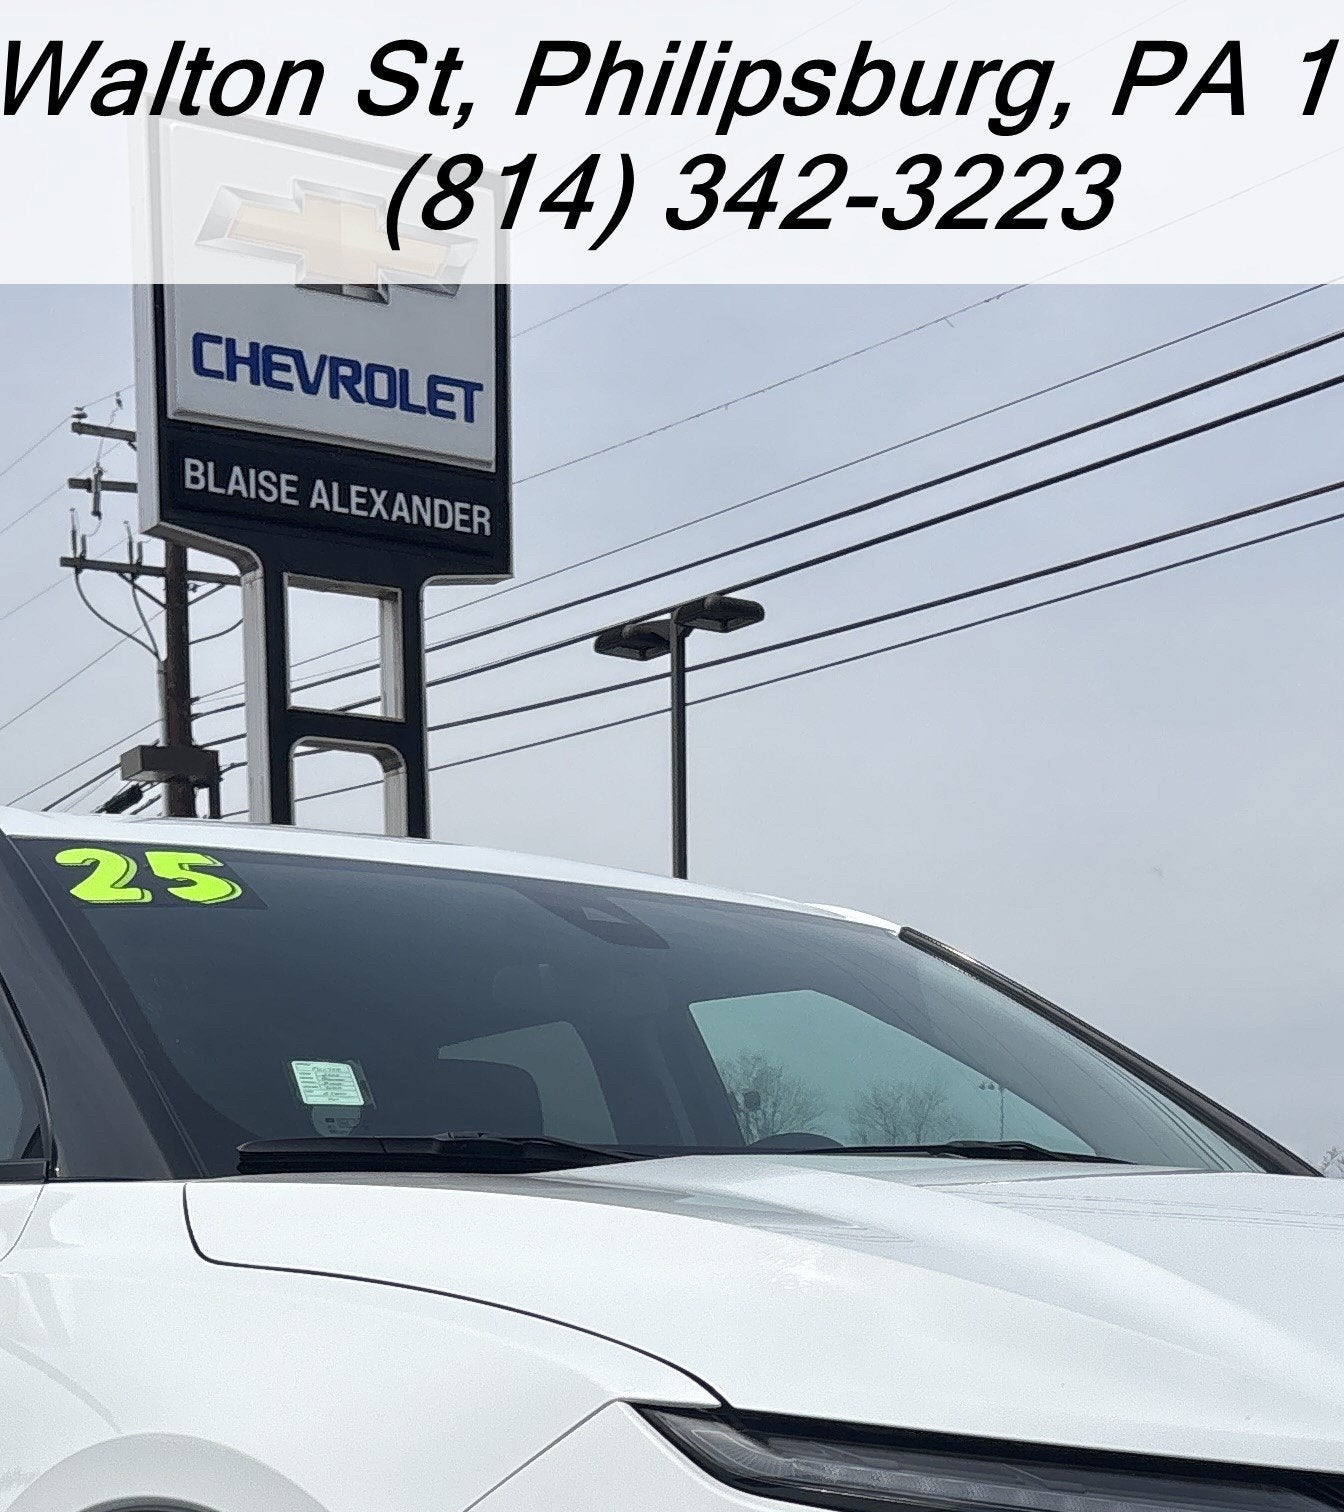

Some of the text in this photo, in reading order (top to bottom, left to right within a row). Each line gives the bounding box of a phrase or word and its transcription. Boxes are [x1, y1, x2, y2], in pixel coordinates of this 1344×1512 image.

[192, 331, 483, 423] CHEVROLET
[184, 457, 493, 537] BLAISE ALEXANDER
[54, 847, 244, 904] 25
